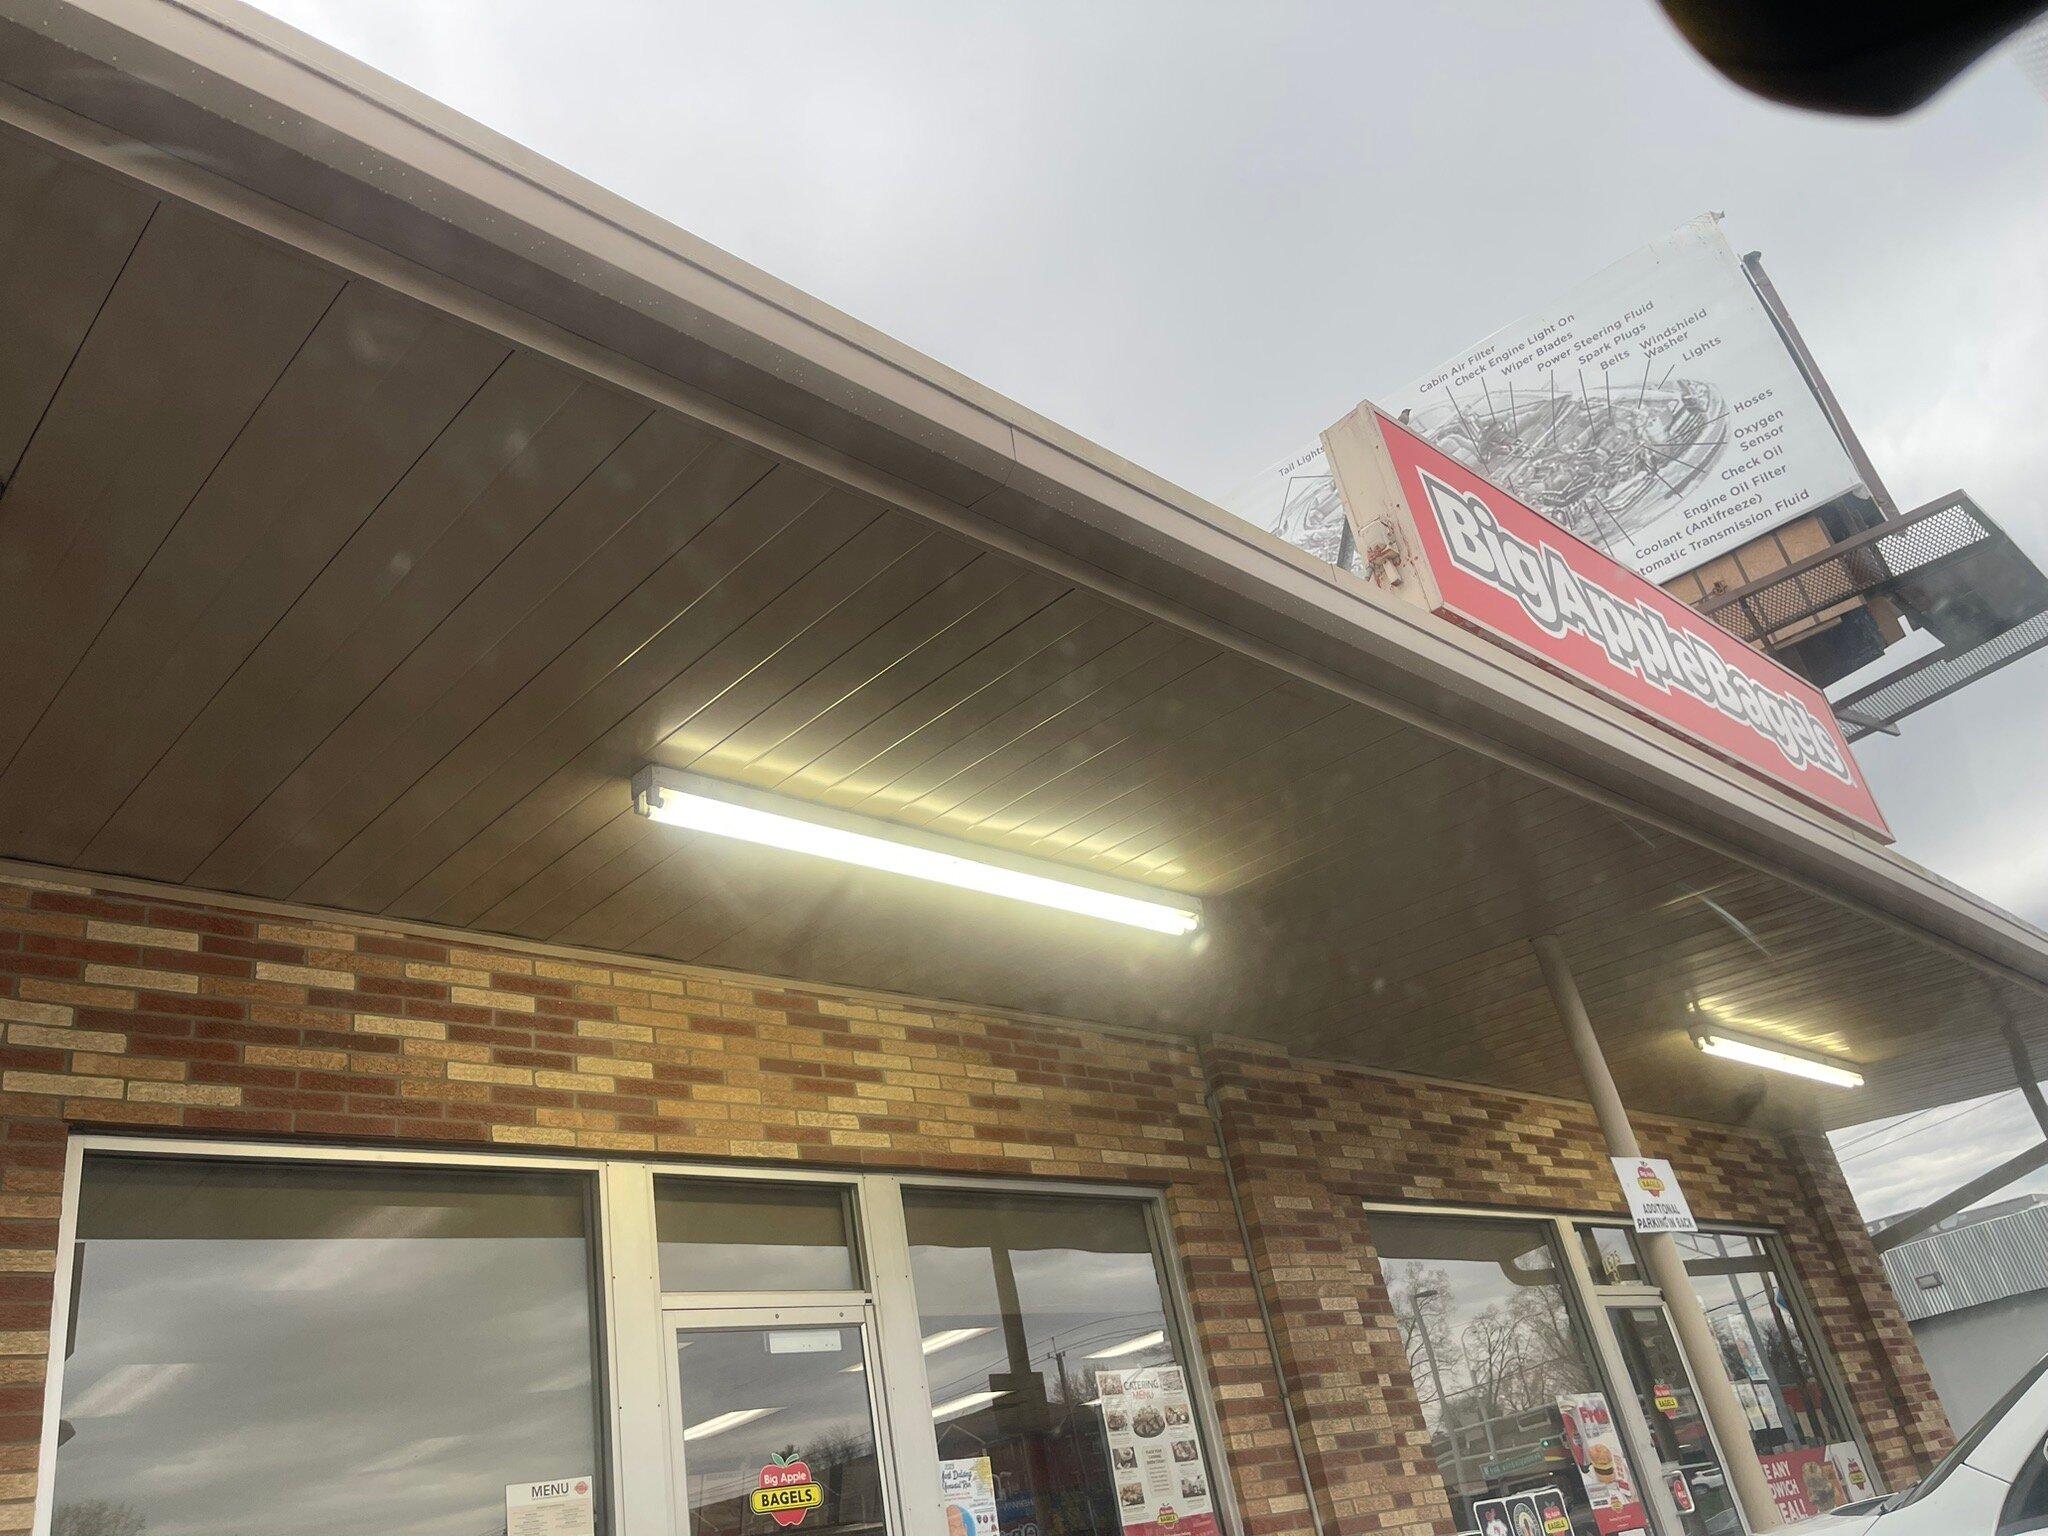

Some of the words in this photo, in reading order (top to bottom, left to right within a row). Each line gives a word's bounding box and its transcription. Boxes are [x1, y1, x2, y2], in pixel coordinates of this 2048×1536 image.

[1537, 348, 1571, 372] Power
[1574, 320, 1622, 352] Steering
[1624, 300, 1654, 323] Fluid
[1579, 342, 1612, 365] Spark
[1613, 323, 1646, 346] Plugs
[1639, 308, 1707, 350] Windshield
[1455, 364, 1487, 386] Check
[1488, 343, 1525, 367] Engine
[1527, 324, 1556, 345] Light
[1558, 314, 1575, 327] On
[1501, 354, 1533, 376] Wiper
[1536, 332, 1573, 357] Blades
[1644, 331, 1689, 359] Washer
[1682, 336, 1721, 361] Lights
[1419, 373, 1448, 393] Cabin
[1451, 362, 1465, 376] Air
[1467, 345, 1495, 365] Filter
[1600, 350, 1630, 371] Belts
[1734, 387, 1774, 412] Hoses
[1734, 409, 1784, 439] Oxygen
[1740, 424, 1785, 452] Sensor
[1278, 463, 1295, 477] Tail
[1721, 454, 1761, 481] Check
[1763, 445, 1784, 460] Oil
[1683, 493, 1728, 519] Engine
[1730, 481, 1750, 497] Oil
[1752, 463, 1788, 488] Filter
[1635, 531, 1683, 559] Coolant
[1685, 493, 1763, 536] (Antifreeze)
[1639, 548, 1687, 576] tomatic
[1689, 508, 1773, 551] Transmission
[1776, 489, 1810, 512] Fluid
[763, 1474, 778, 1486] Big
[780, 1471, 807, 1484] Apple
[1772, 1460, 1791, 1479] ANY
[531, 1483, 569, 1498] MENU
[761, 1489, 813, 1507] BAGELS
